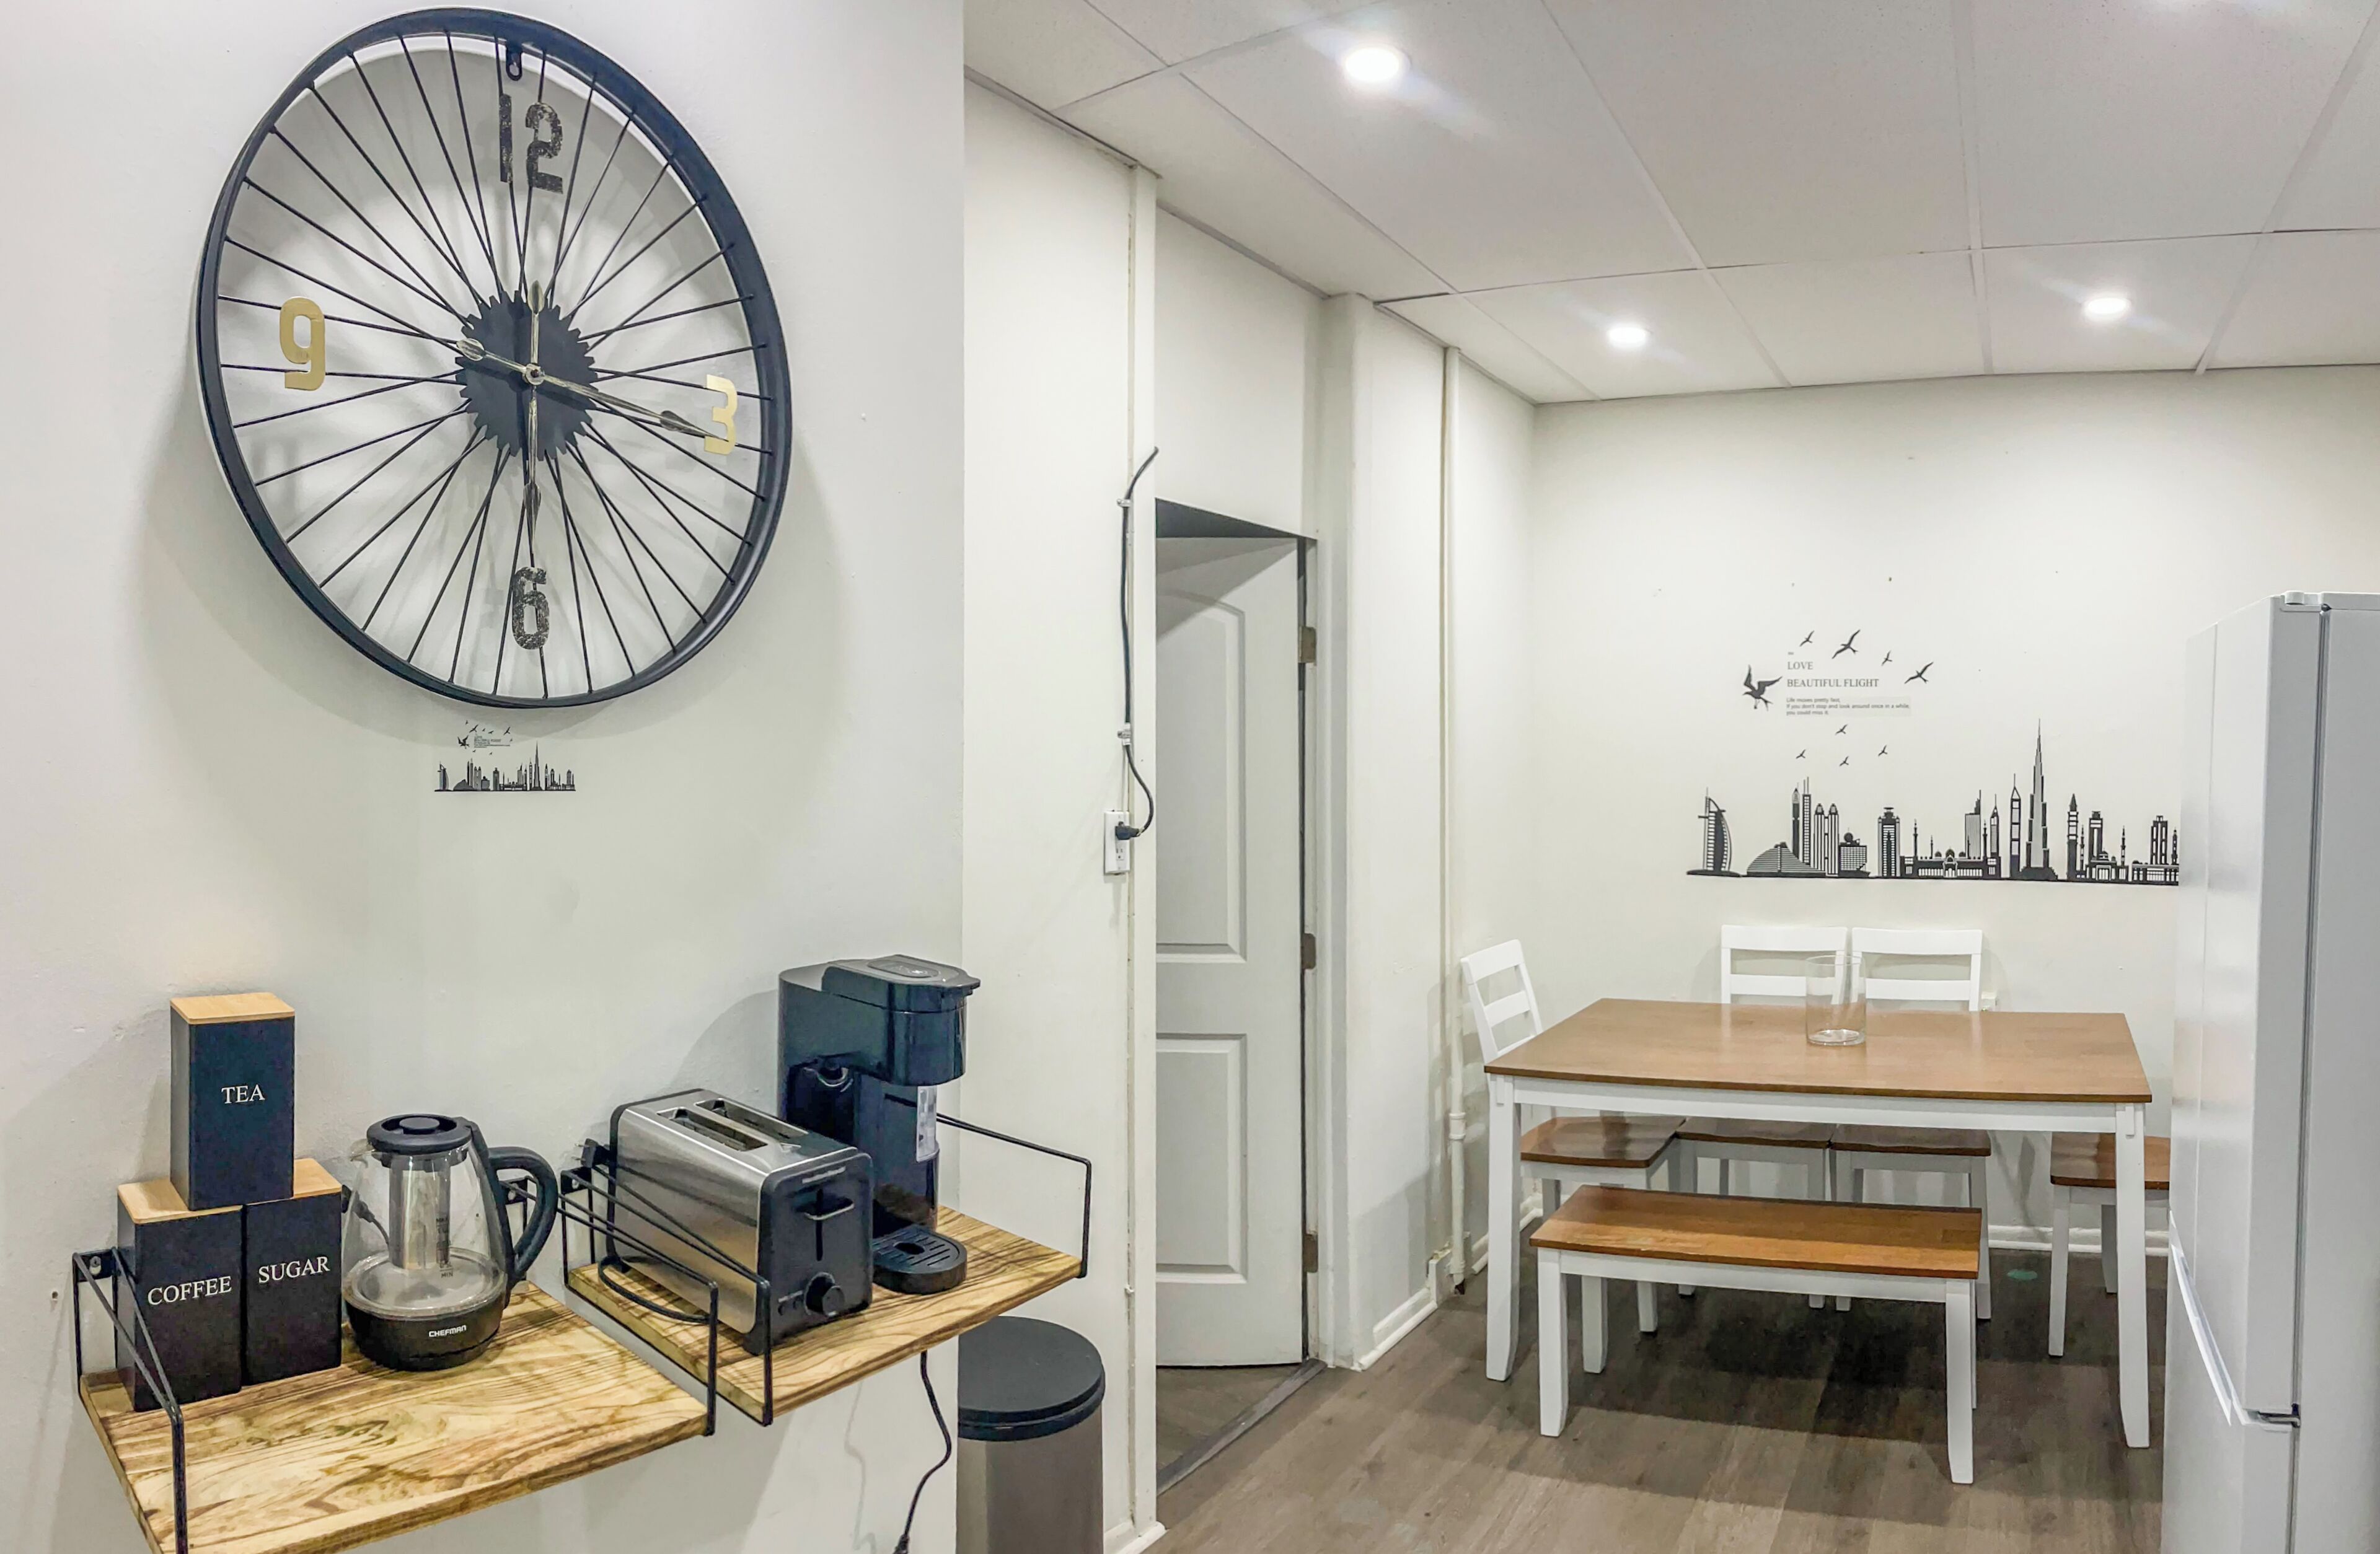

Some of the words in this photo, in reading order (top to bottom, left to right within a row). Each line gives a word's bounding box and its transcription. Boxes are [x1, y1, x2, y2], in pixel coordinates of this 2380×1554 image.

[499, 94, 563, 195] 12
[280, 297, 326, 392] 9
[703, 374, 738, 456] 3
[511, 566, 550, 650] 6
[1787, 661, 1814, 670] LOVE
[1787, 678, 1842, 687] BEAUTIFUL
[1843, 678, 1880, 687] FLIGHT
[221, 1084, 266, 1104] TEA
[258, 1255, 331, 1284] SUGAR
[147, 1275, 233, 1306] COFFEE
[428, 1324, 467, 1338] CHEFMAN
